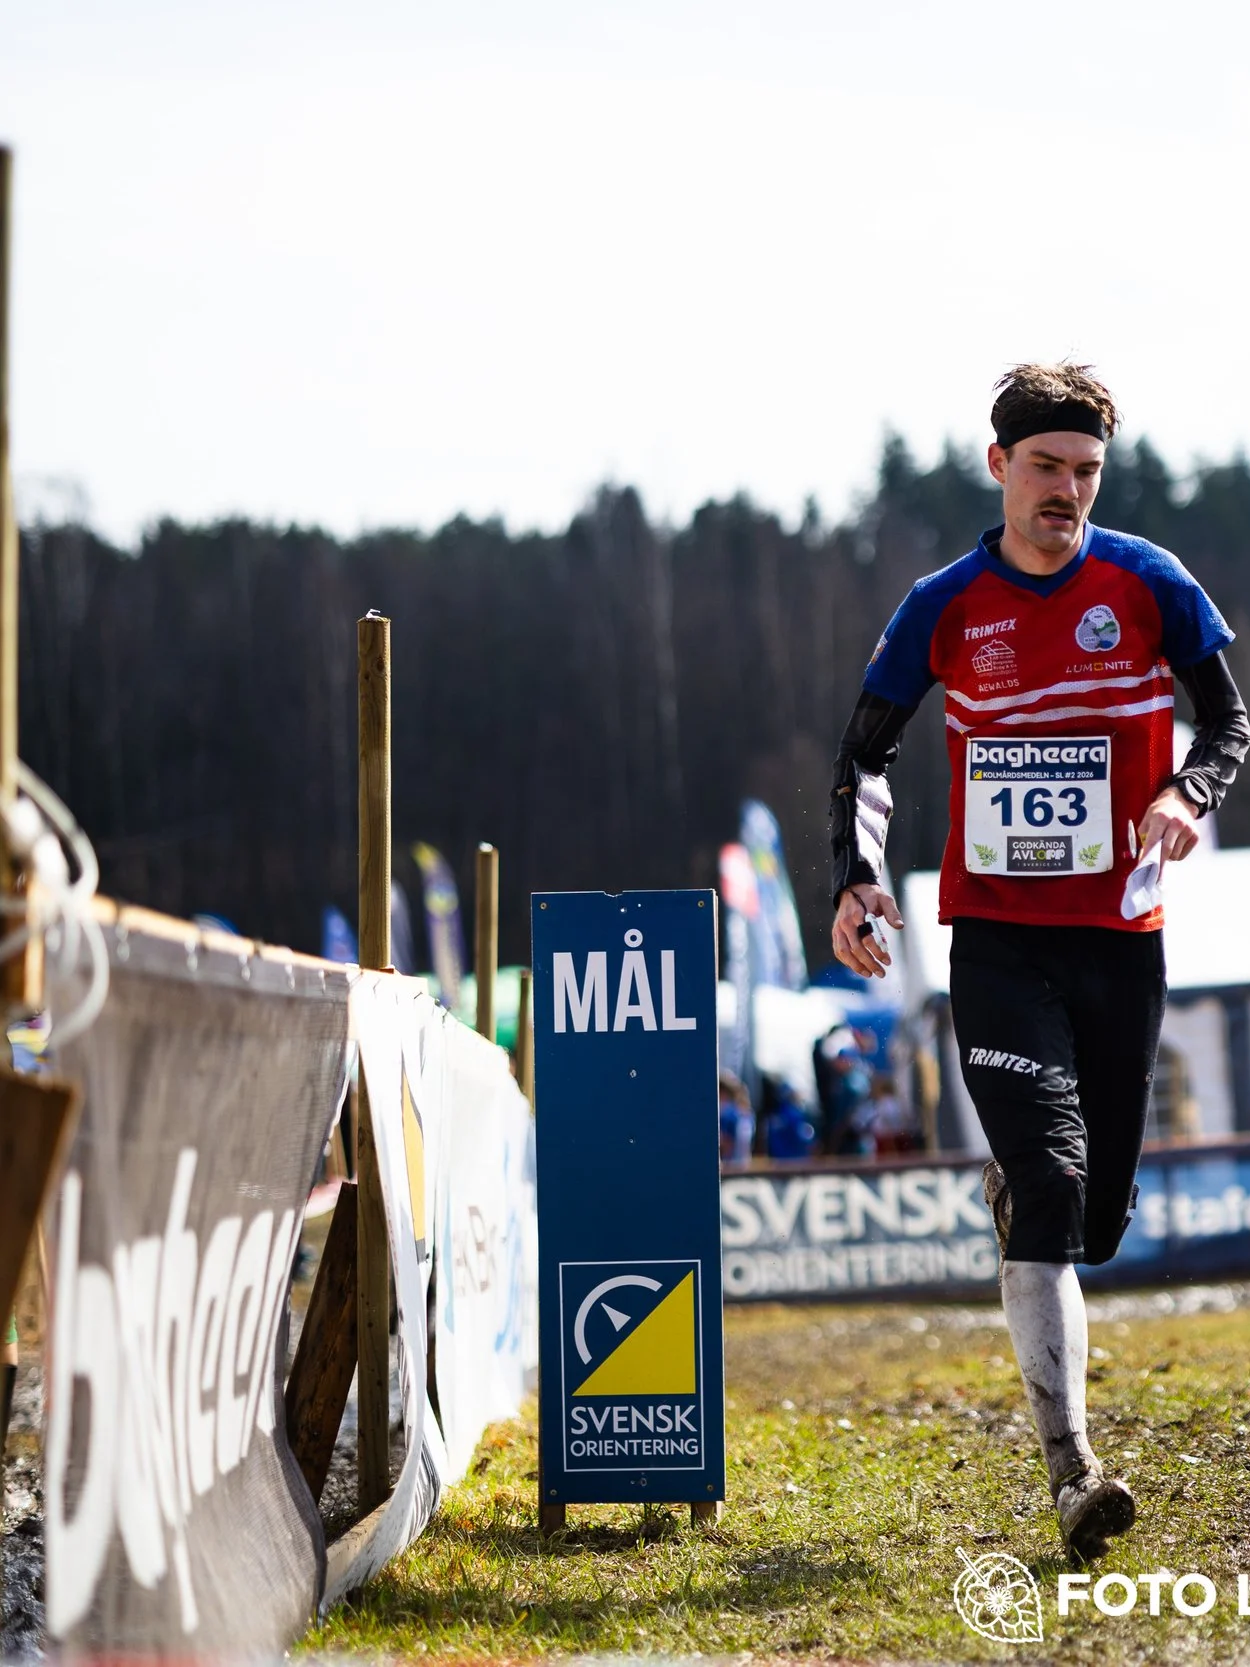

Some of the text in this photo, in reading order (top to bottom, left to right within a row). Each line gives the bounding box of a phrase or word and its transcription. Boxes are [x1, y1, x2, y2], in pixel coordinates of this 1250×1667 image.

[964, 618, 1017, 641] TRIMTEX
[1065, 660, 1133, 674] LUMONITE
[971, 742, 1106, 768] bagheera
[982, 770, 1050, 779] KOLMÅRDSMEDELN
[990, 787, 1088, 828] 163
[1012, 840, 1066, 849] GODKÄNDA
[1012, 849, 1066, 860] AVLOPP
[553, 928, 696, 1033] MÅL
[968, 1047, 1043, 1077] TRIMTEX
[720, 1168, 992, 1247] SVENSK
[721, 1234, 998, 1297] ORIENTERING
[571, 1405, 697, 1435] SVENSK
[570, 1438, 699, 1457] ORIENTERING
